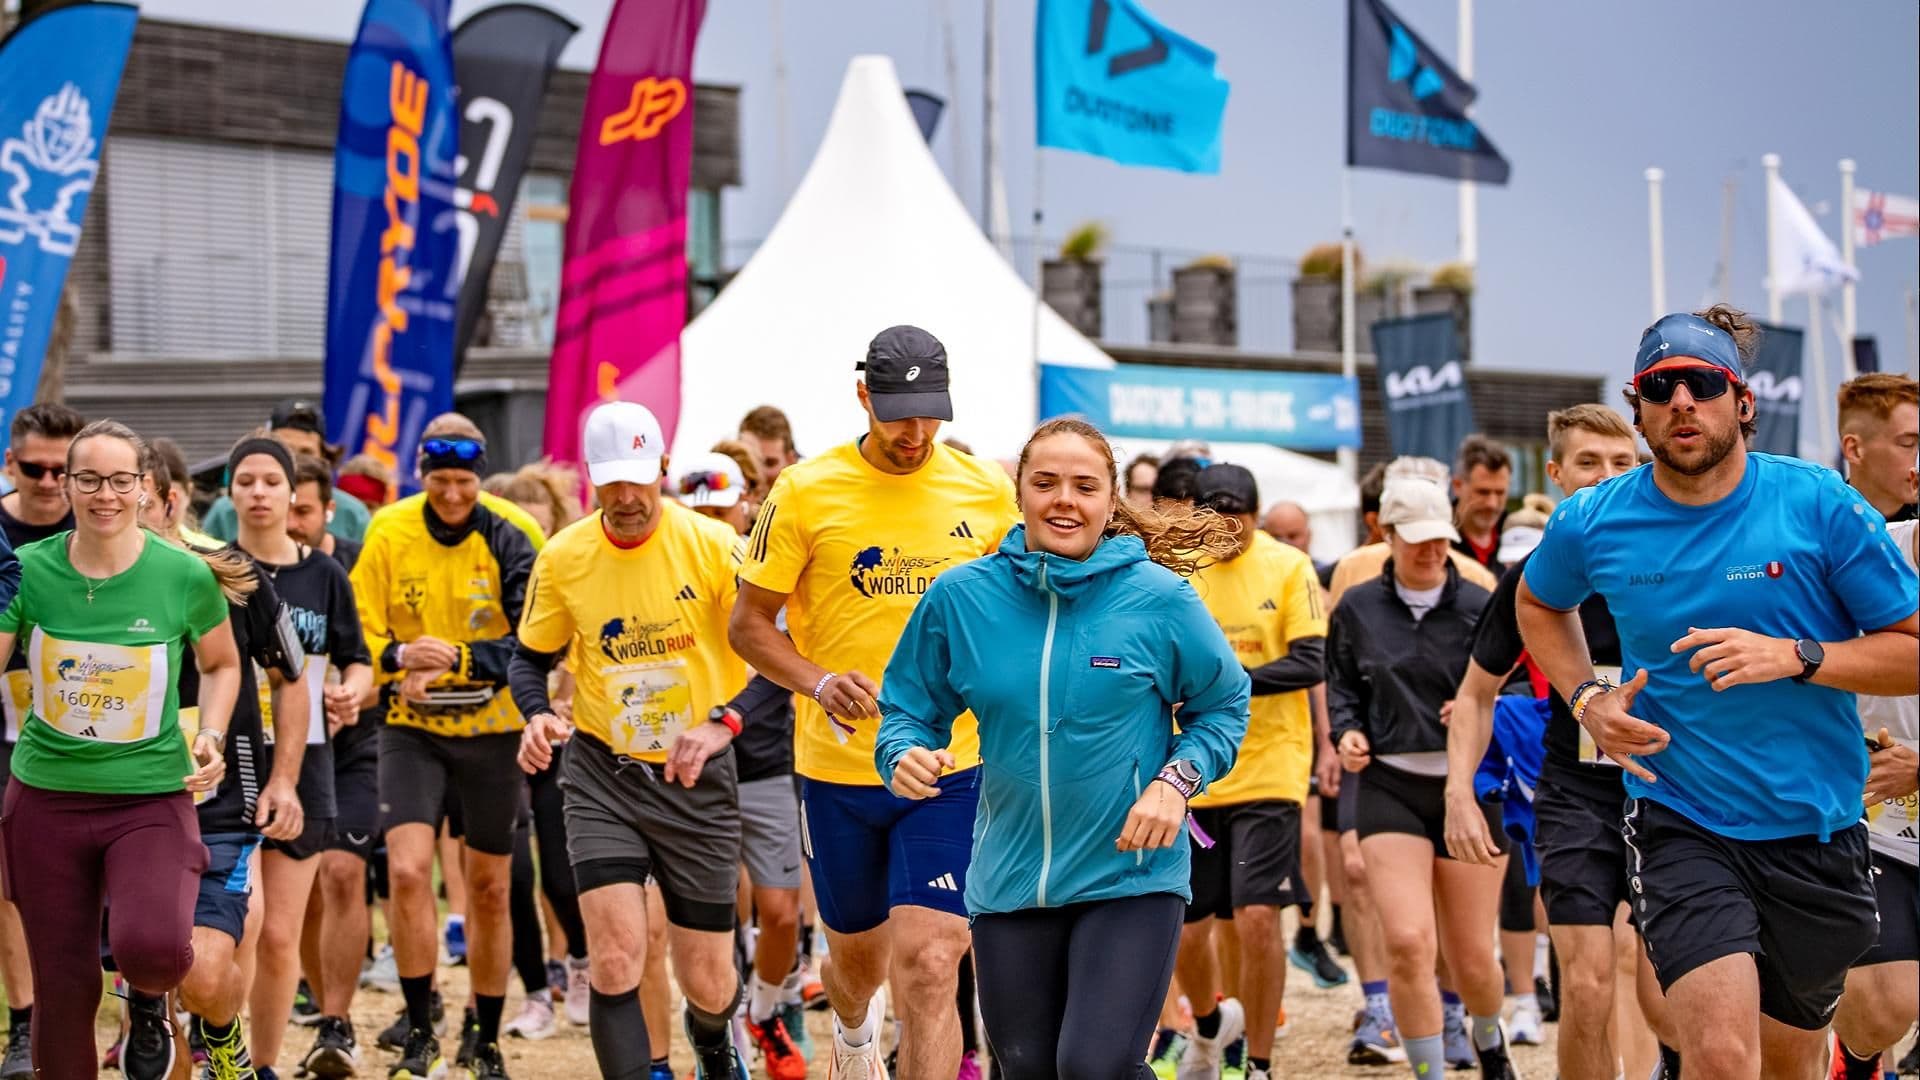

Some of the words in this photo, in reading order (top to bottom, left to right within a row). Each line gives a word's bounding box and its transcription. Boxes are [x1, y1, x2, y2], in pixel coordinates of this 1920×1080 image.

[1065, 84, 1176, 136] DUOTONE
[889, 567, 912, 577] LIFE
[1727, 564, 1763, 573] SPORT
[868, 577, 927, 595] WORLD
[1629, 573, 1664, 587] JAKO
[616, 639, 666, 660] WORLD
[666, 632, 696, 653] RUN
[59, 689, 125, 710] 160783
[626, 711, 677, 727] 132541
